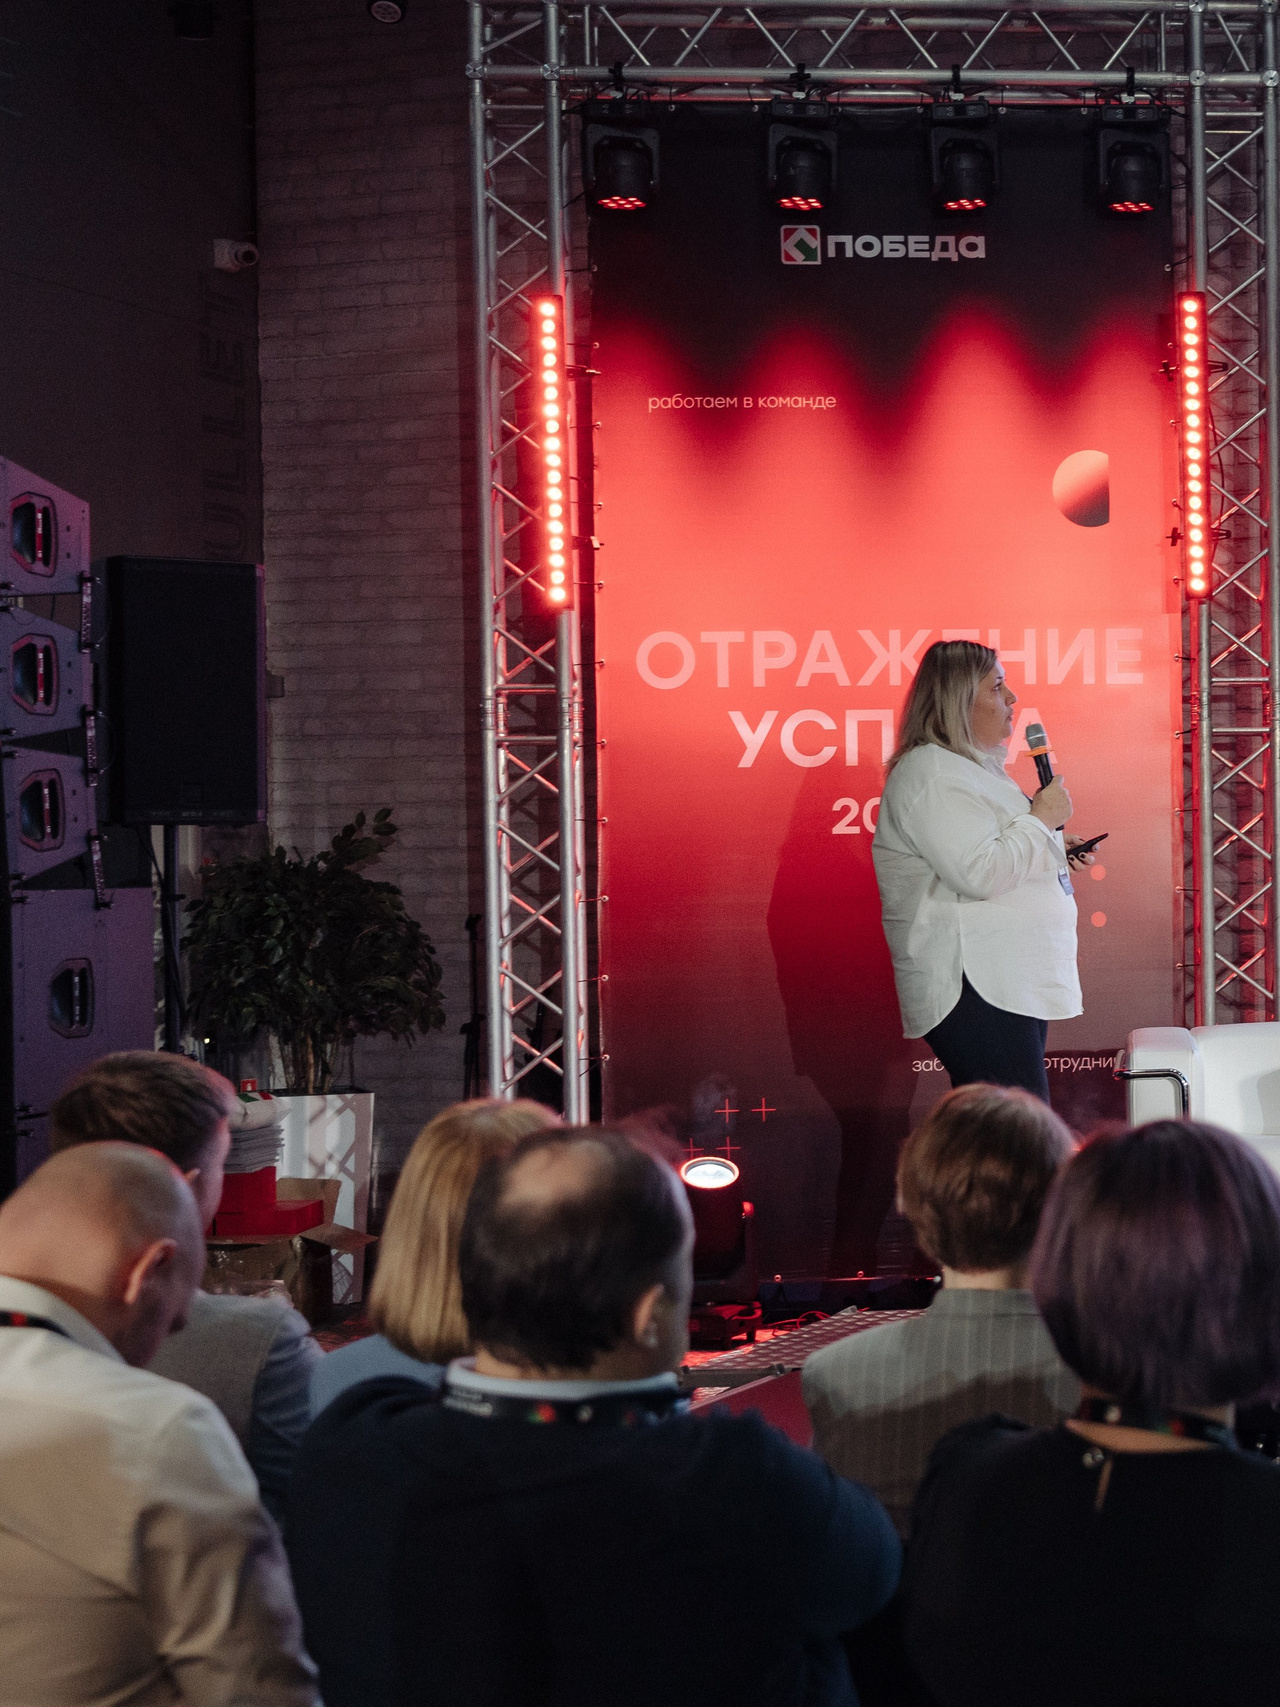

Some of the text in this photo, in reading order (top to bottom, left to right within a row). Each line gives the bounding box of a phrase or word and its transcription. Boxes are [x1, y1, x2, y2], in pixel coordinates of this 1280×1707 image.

[648, 393, 837, 413] работаем в команде
[635, 628, 1145, 690] ОТРАЖНИЕ
[727, 708, 1059, 769] УСПА
[911, 1057, 945, 1072] заб
